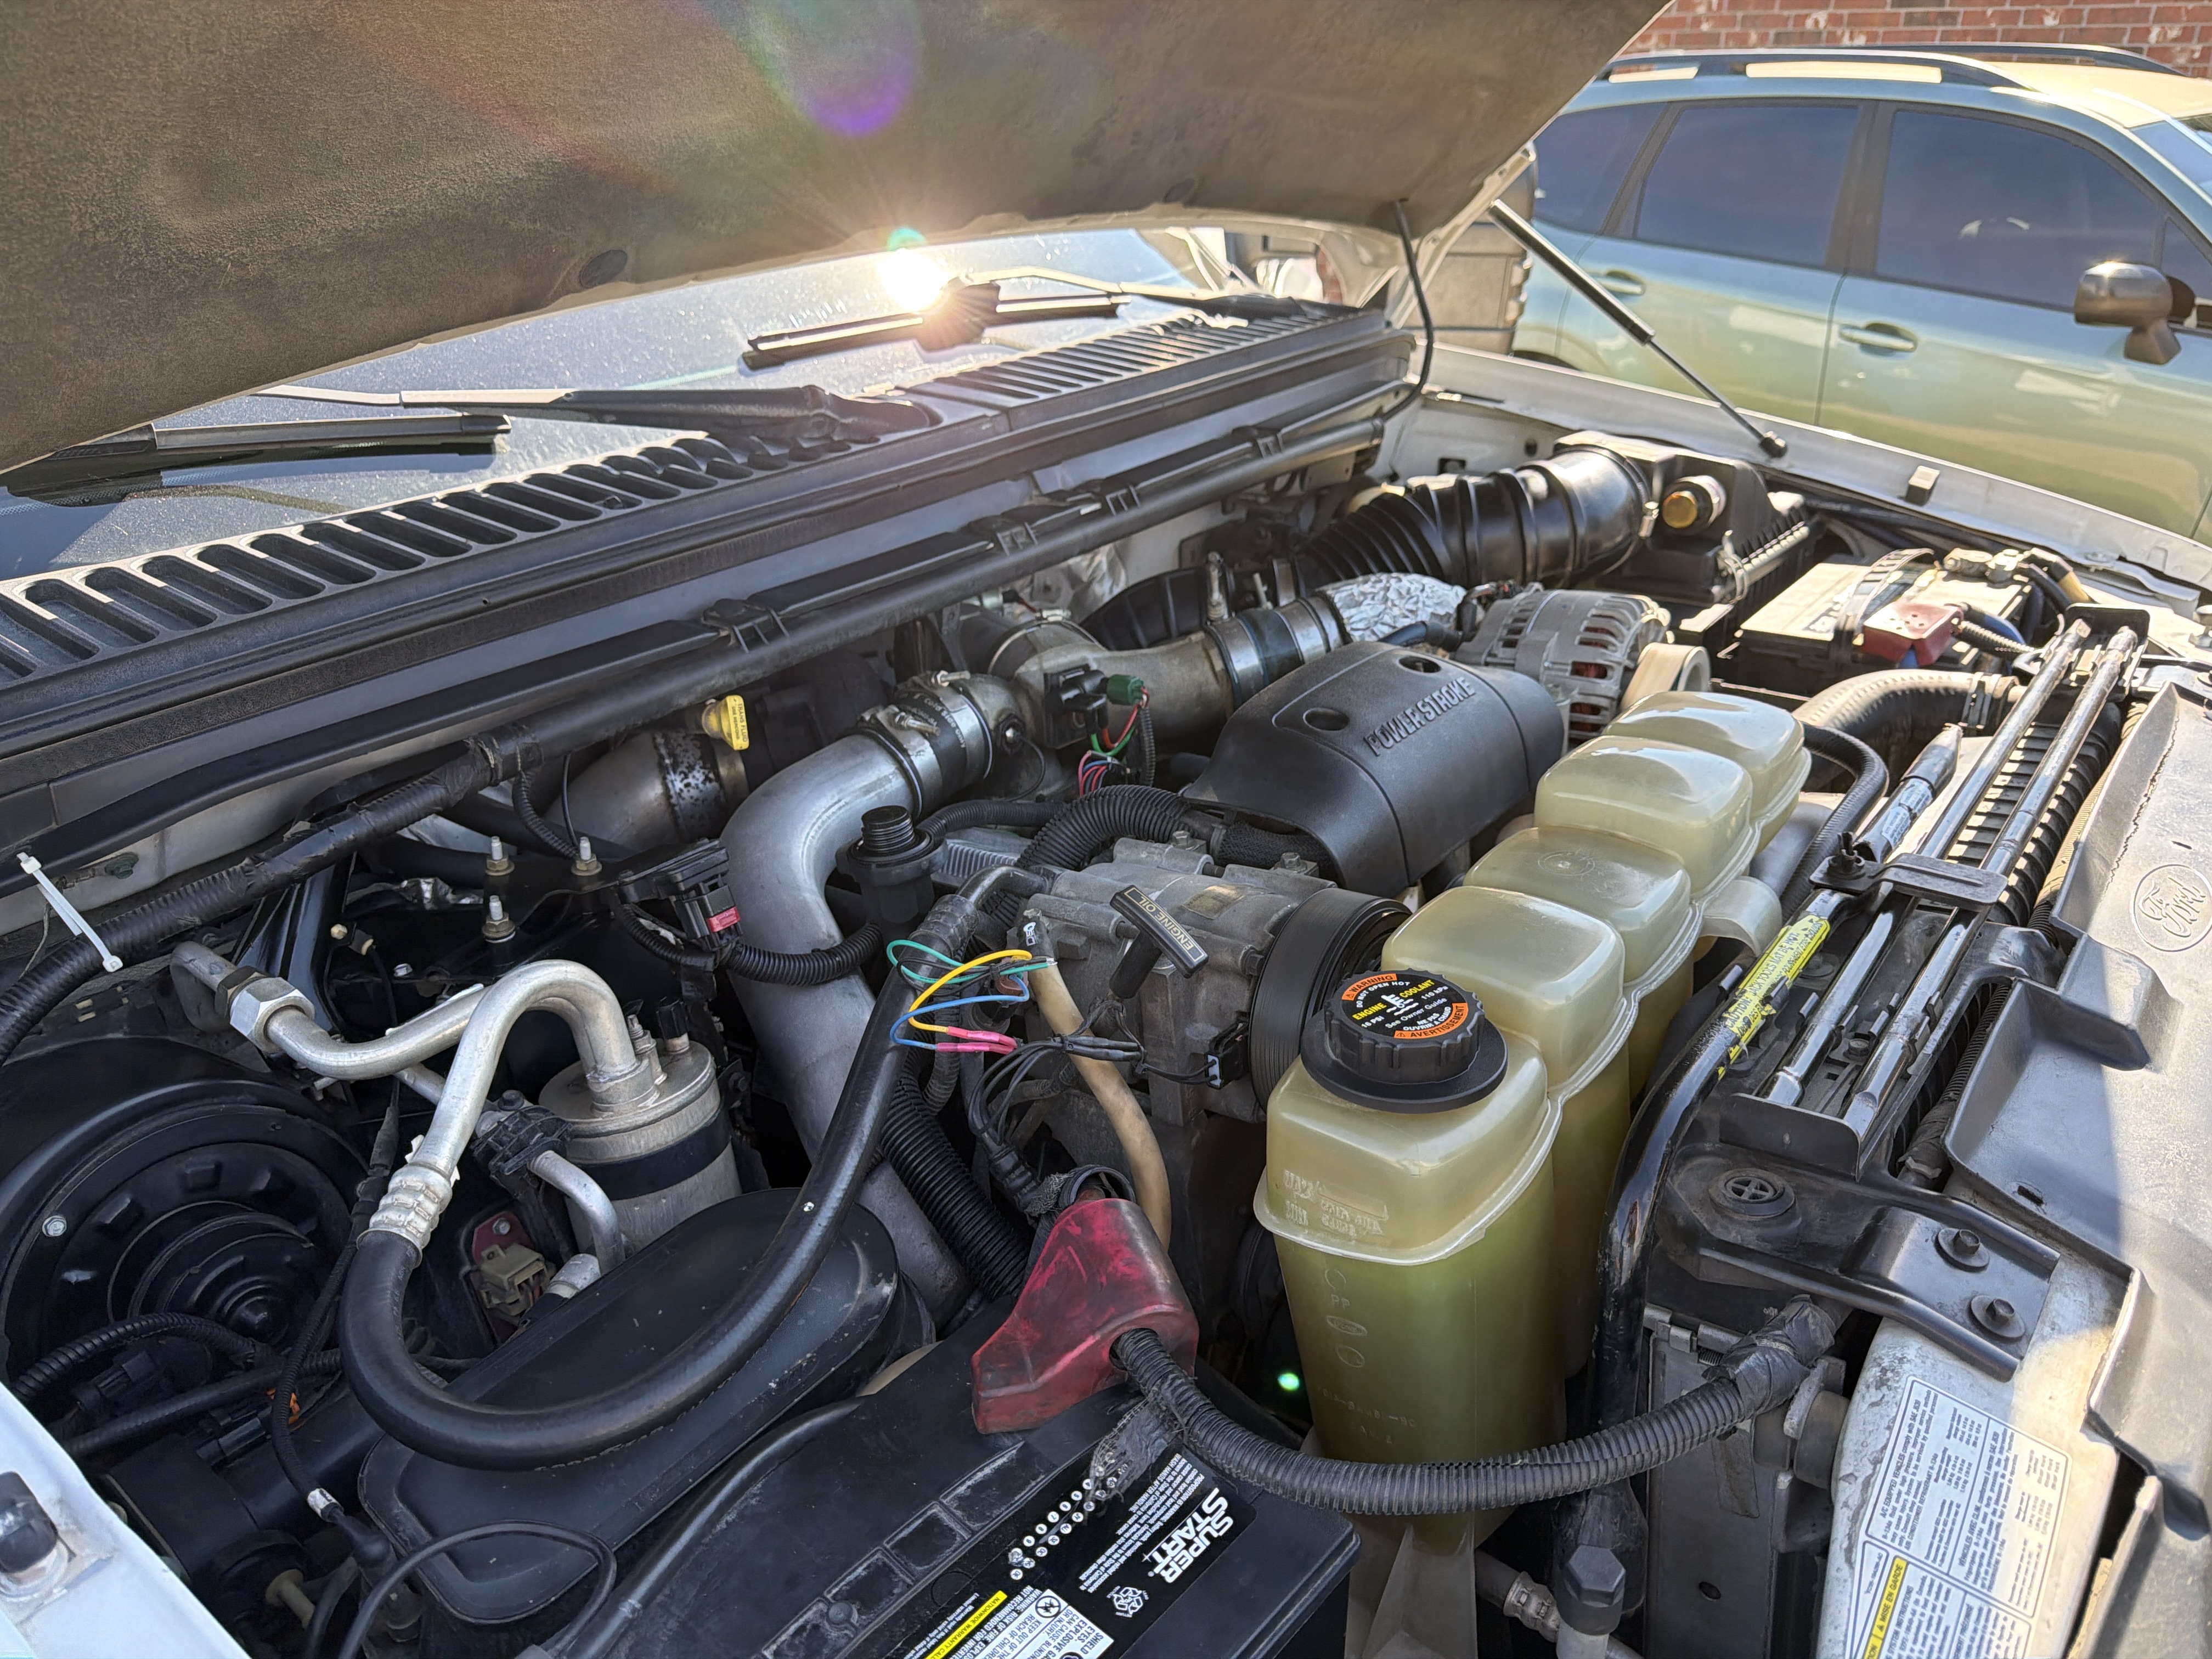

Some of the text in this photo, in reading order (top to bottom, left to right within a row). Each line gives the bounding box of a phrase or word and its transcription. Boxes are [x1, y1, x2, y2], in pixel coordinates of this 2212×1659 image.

[1415, 673, 1476, 724] STROKE
[1137, 893, 1157, 915] OIL
[1154, 909, 1194, 952] ENGINE
[1747, 977, 1764, 997] JACK
[1769, 950, 1785, 966] MAY
[1777, 942, 1790, 955] BE
[1350, 975, 1393, 992] WARNING
[1359, 989, 1369, 1000] NOT
[1370, 982, 1390, 991] OPEN
[1352, 979, 1435, 1020] ENGINE COOLANT
[1356, 1000, 1363, 1008] DO
[1361, 986, 1449, 1028] 16 PSI 110 kPa
[1385, 998, 1447, 1029] See Owner Guide
[1410, 1005, 1464, 1037] AVERTISSEMENT
[1427, 1012, 1440, 1023] PAS
[1438, 1006, 1452, 1023] CHAUD
[1167, 1452, 1182, 1468] WASH
[1879, 1398, 1921, 1519] A/C EQUIPPED VEHICLES comply with SAE J639
[1156, 1465, 1172, 1482] HANDS
[1146, 1479, 1161, 1494] AFTER
[1180, 1473, 1205, 1501] PROPOSITION
[1152, 1487, 1228, 1574] START
[1159, 1510, 1234, 1583] SUPER
[1013, 1588, 1042, 1613] WARNING:
[1878, 1563, 1903, 1623] MISE EN GARDE
[968, 1596, 1001, 1625] NATIONWIDE
[972, 1584, 1034, 1641] NOT RECOMMENDED FOR
[1002, 1610, 1018, 1624] RISK
[1064, 1613, 1080, 1626] CAN
[995, 1621, 1006, 1631] OF
[1014, 1613, 1036, 1632] REACH
[1024, 1618, 1042, 1634] KEEP
[1041, 1608, 1073, 1637] OR INJURY.
[1047, 1623, 1069, 1643] CAUSE
[942, 1622, 973, 1649] WARRANTY
[1007, 1629, 1019, 1640] OF
[1014, 1631, 1029, 1644] OUT
[1050, 1618, 1090, 1653] EXPLOSIVE
[1073, 1625, 1096, 1645] EYES.
[1078, 1632, 1105, 1655] SHIELD
[1006, 1641, 1018, 1652] OF
